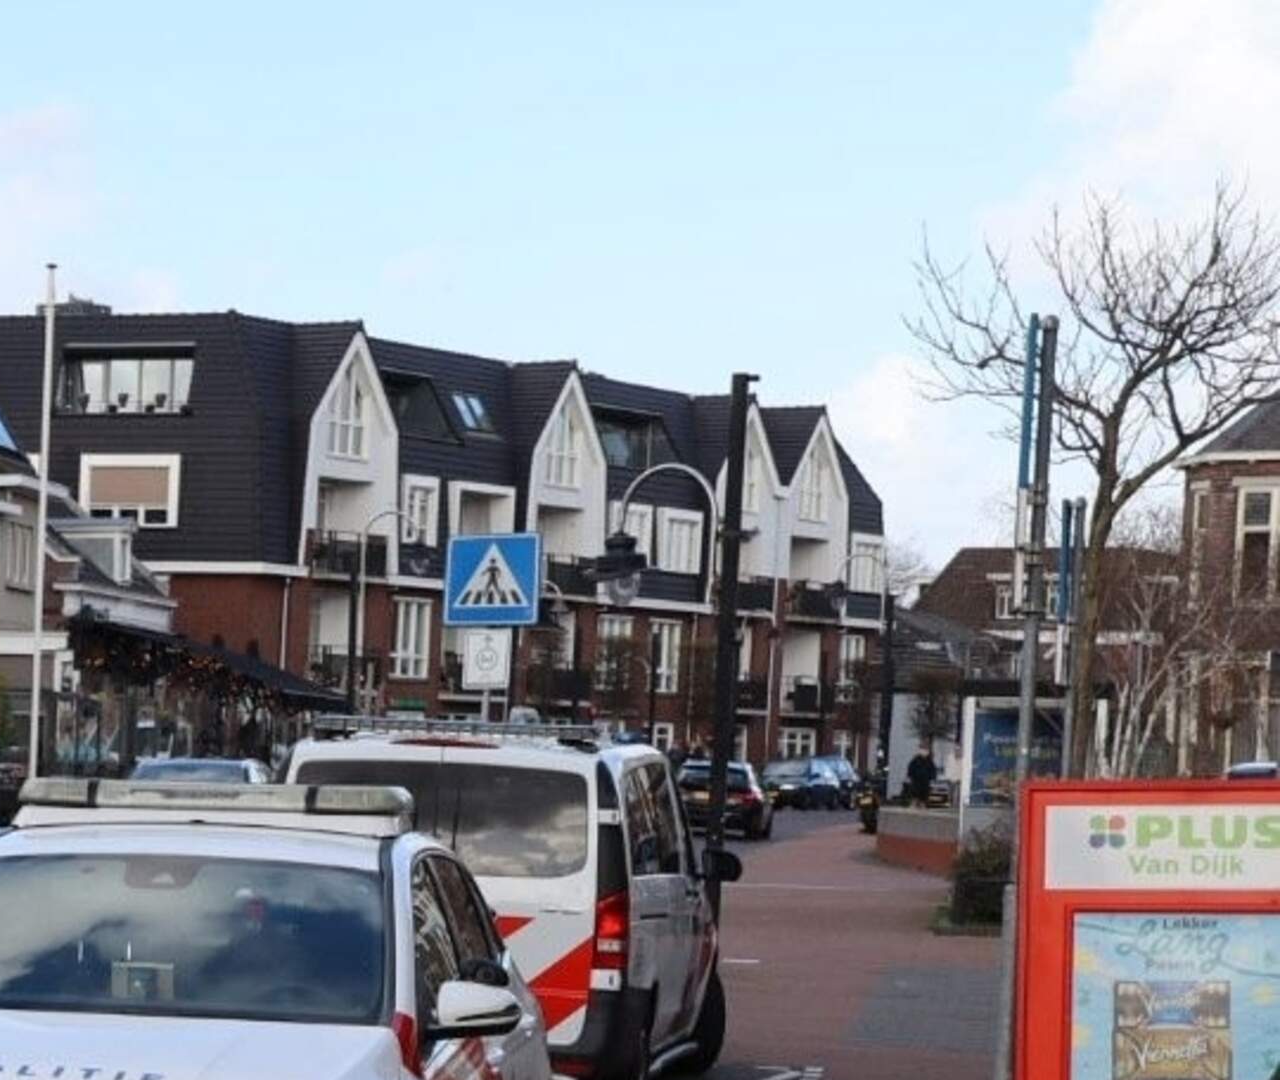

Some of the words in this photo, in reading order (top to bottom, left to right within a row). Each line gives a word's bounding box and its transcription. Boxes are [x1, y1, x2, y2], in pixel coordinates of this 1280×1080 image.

[1136, 814, 1280, 848] PLUS
[1129, 855, 1180, 875] Van
[1191, 854, 1244, 878] Dijk
